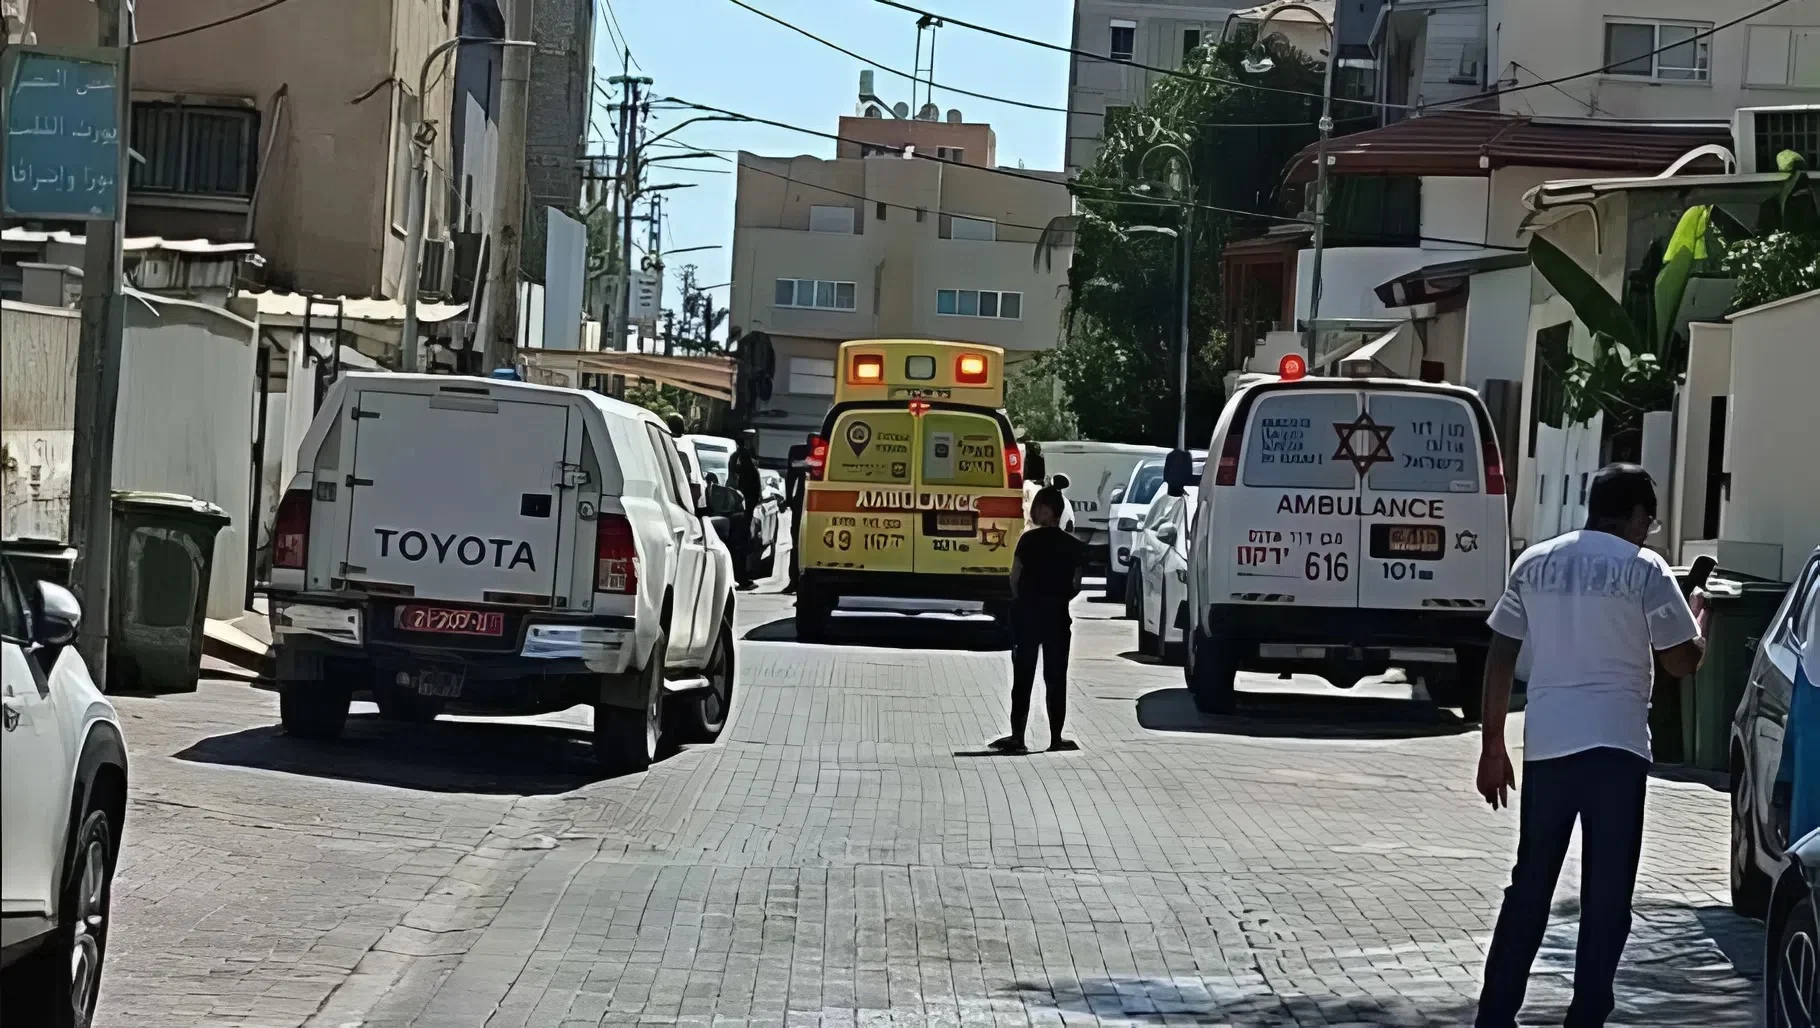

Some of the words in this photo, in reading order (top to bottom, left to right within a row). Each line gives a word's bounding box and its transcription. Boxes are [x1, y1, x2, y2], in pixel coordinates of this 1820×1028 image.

[1277, 494, 1445, 519] AMBULANCE
[374, 528, 537, 573] TOYOTA
[1305, 551, 1349, 582] 616
[1382, 562, 1416, 580] 101
